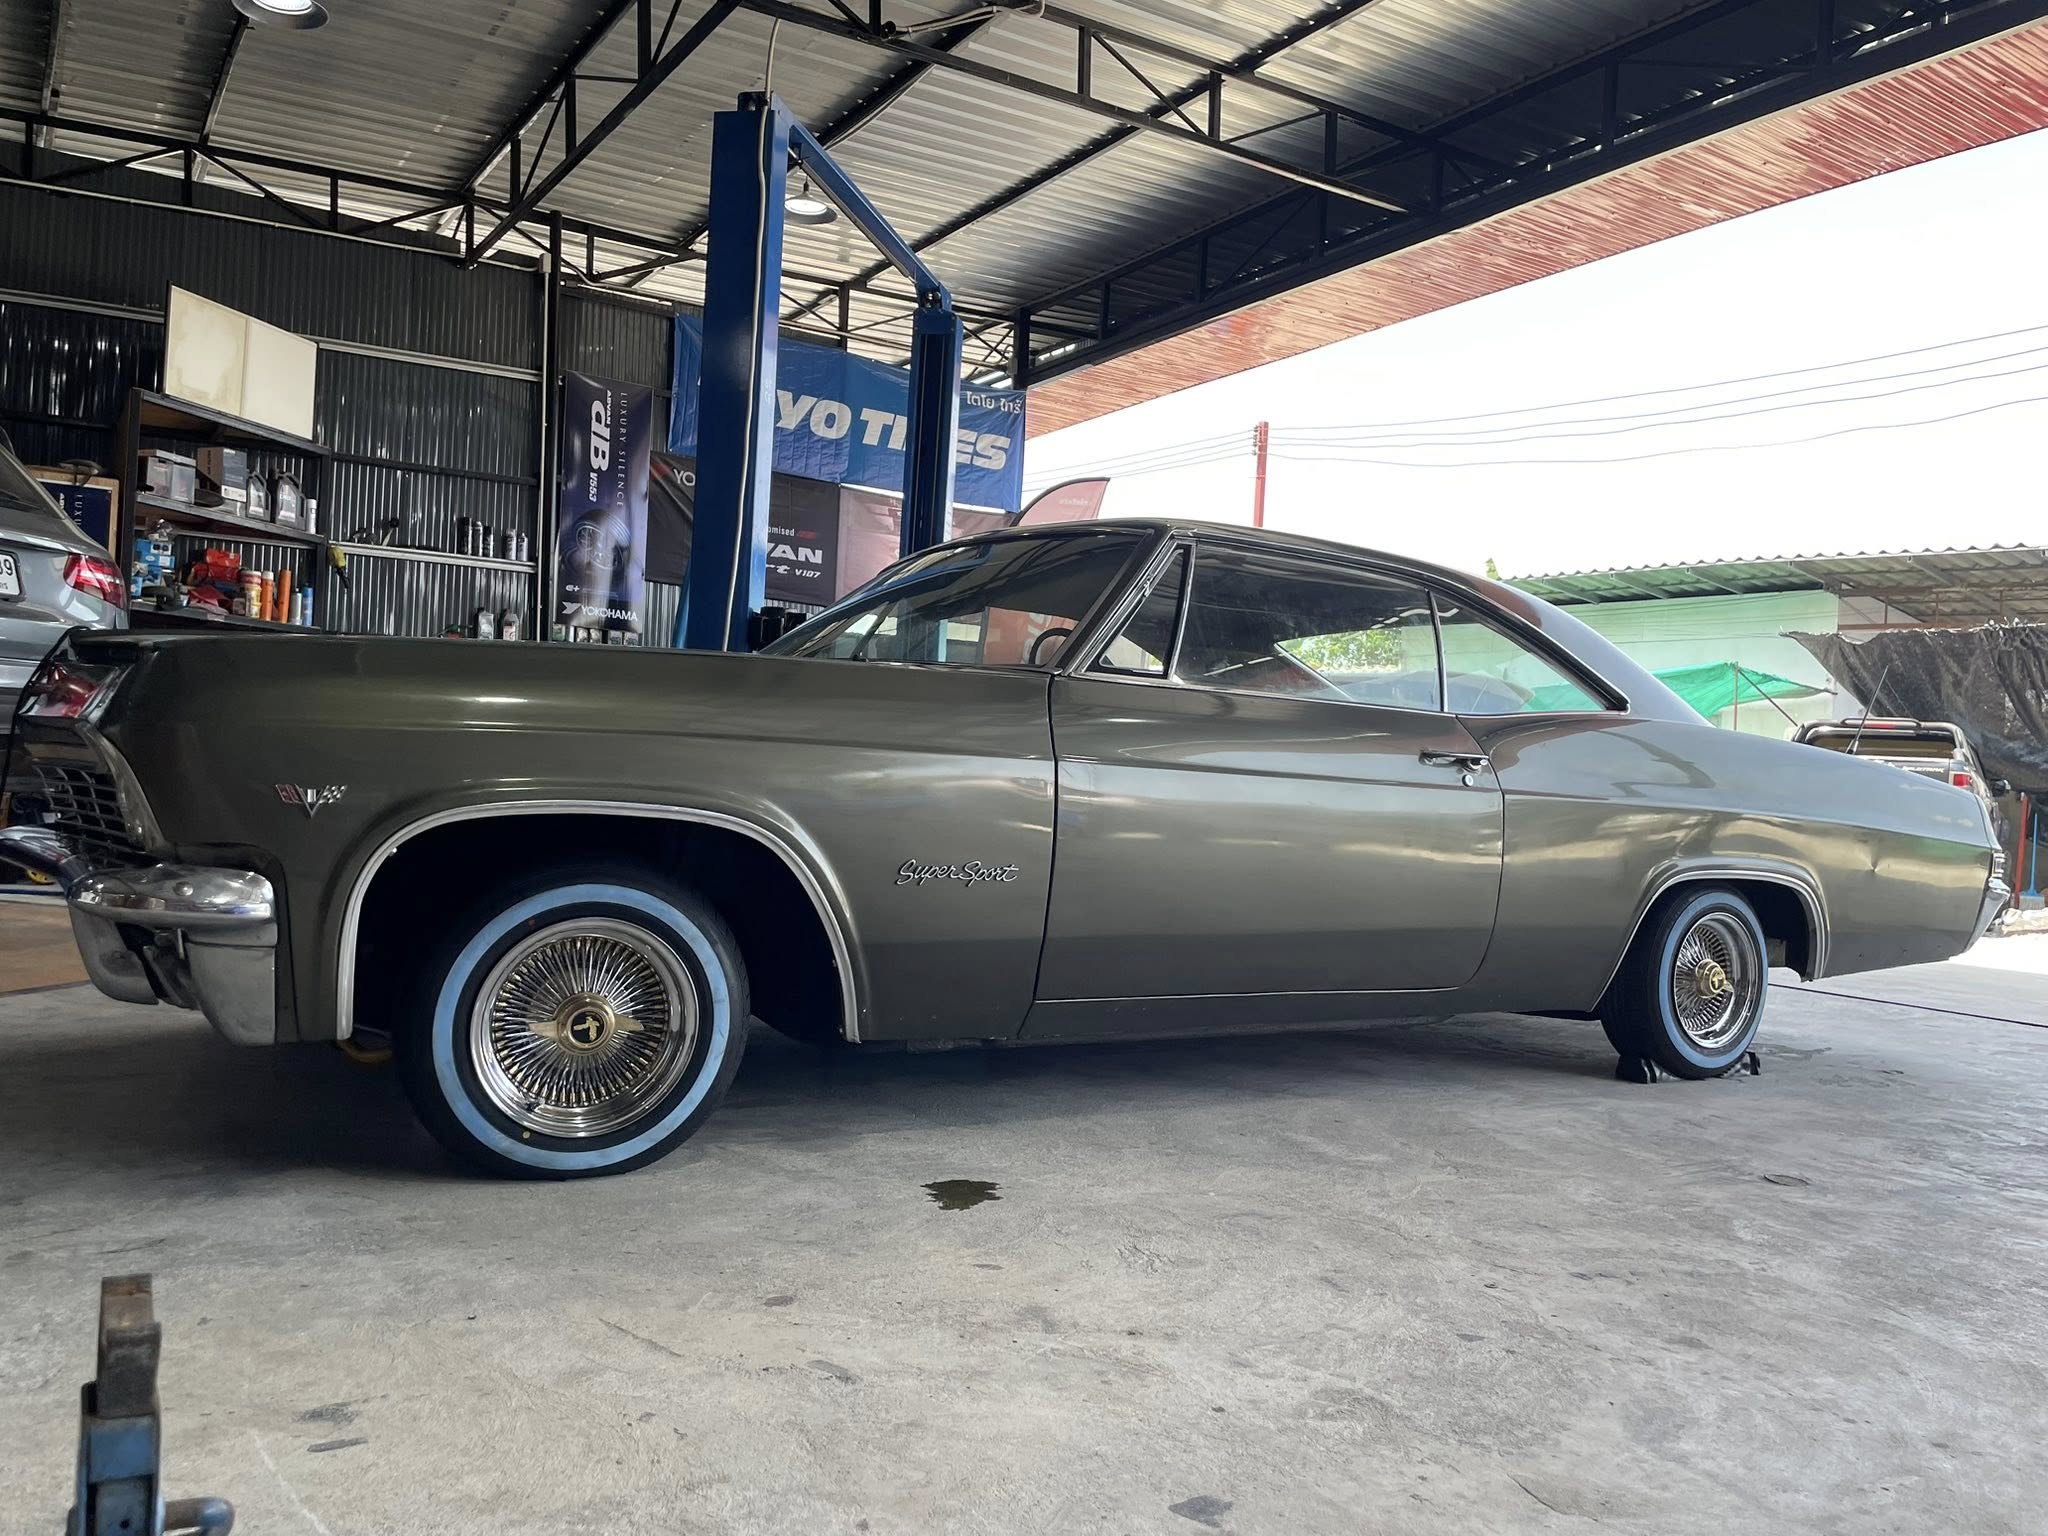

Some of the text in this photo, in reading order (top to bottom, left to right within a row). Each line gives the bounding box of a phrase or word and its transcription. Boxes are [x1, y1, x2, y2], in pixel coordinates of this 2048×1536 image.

[616, 392, 628, 507] LUXURY SILENCE
[860, 408, 1011, 470] TIES
[589, 472, 599, 502] V553
[795, 568, 821, 578] V107
[581, 604, 638, 622] YOKOHAMA
[897, 859, 1019, 887] Super Sport
